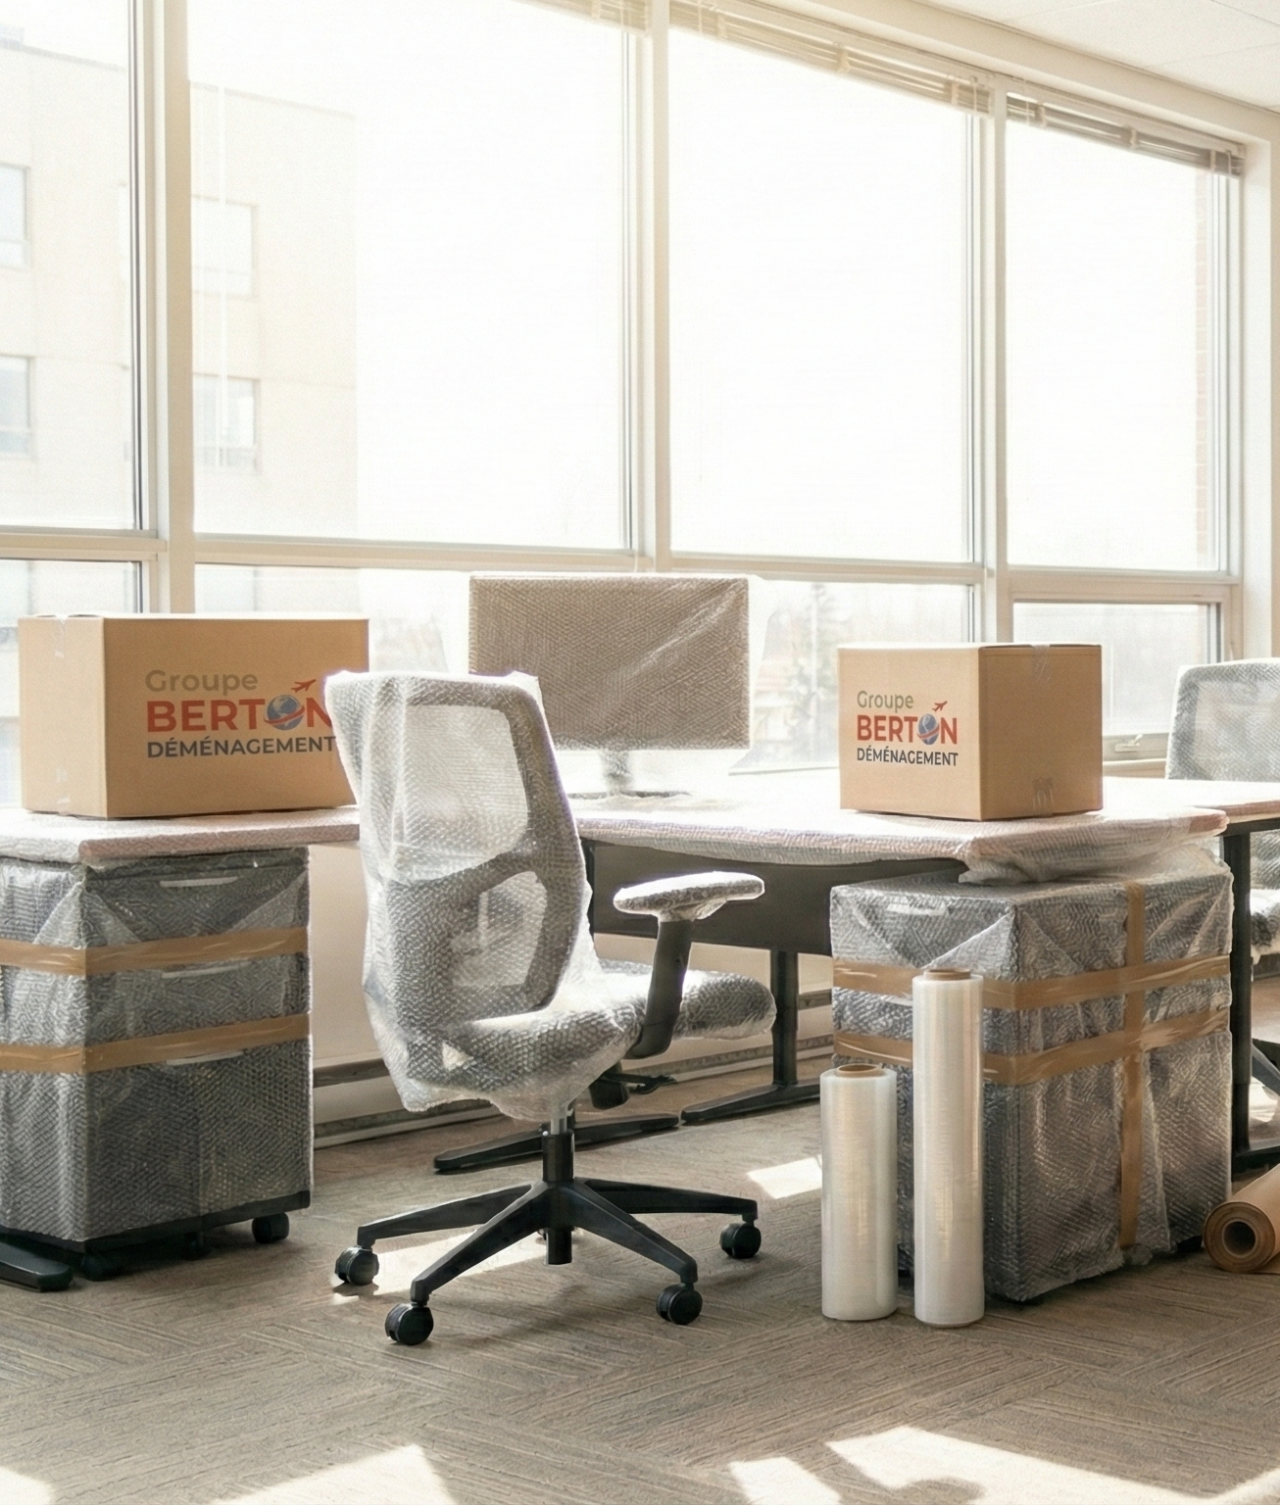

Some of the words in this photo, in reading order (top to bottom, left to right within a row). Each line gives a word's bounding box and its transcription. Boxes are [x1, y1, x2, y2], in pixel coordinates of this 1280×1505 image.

[145, 669, 258, 696] Groupe
[857, 690, 915, 713] Groupe
[857, 713, 958, 745] BERTON
[147, 736, 336, 758] DÉMÉNAGEMENT
[857, 744, 958, 767] DÉMÉNAGEMENT
